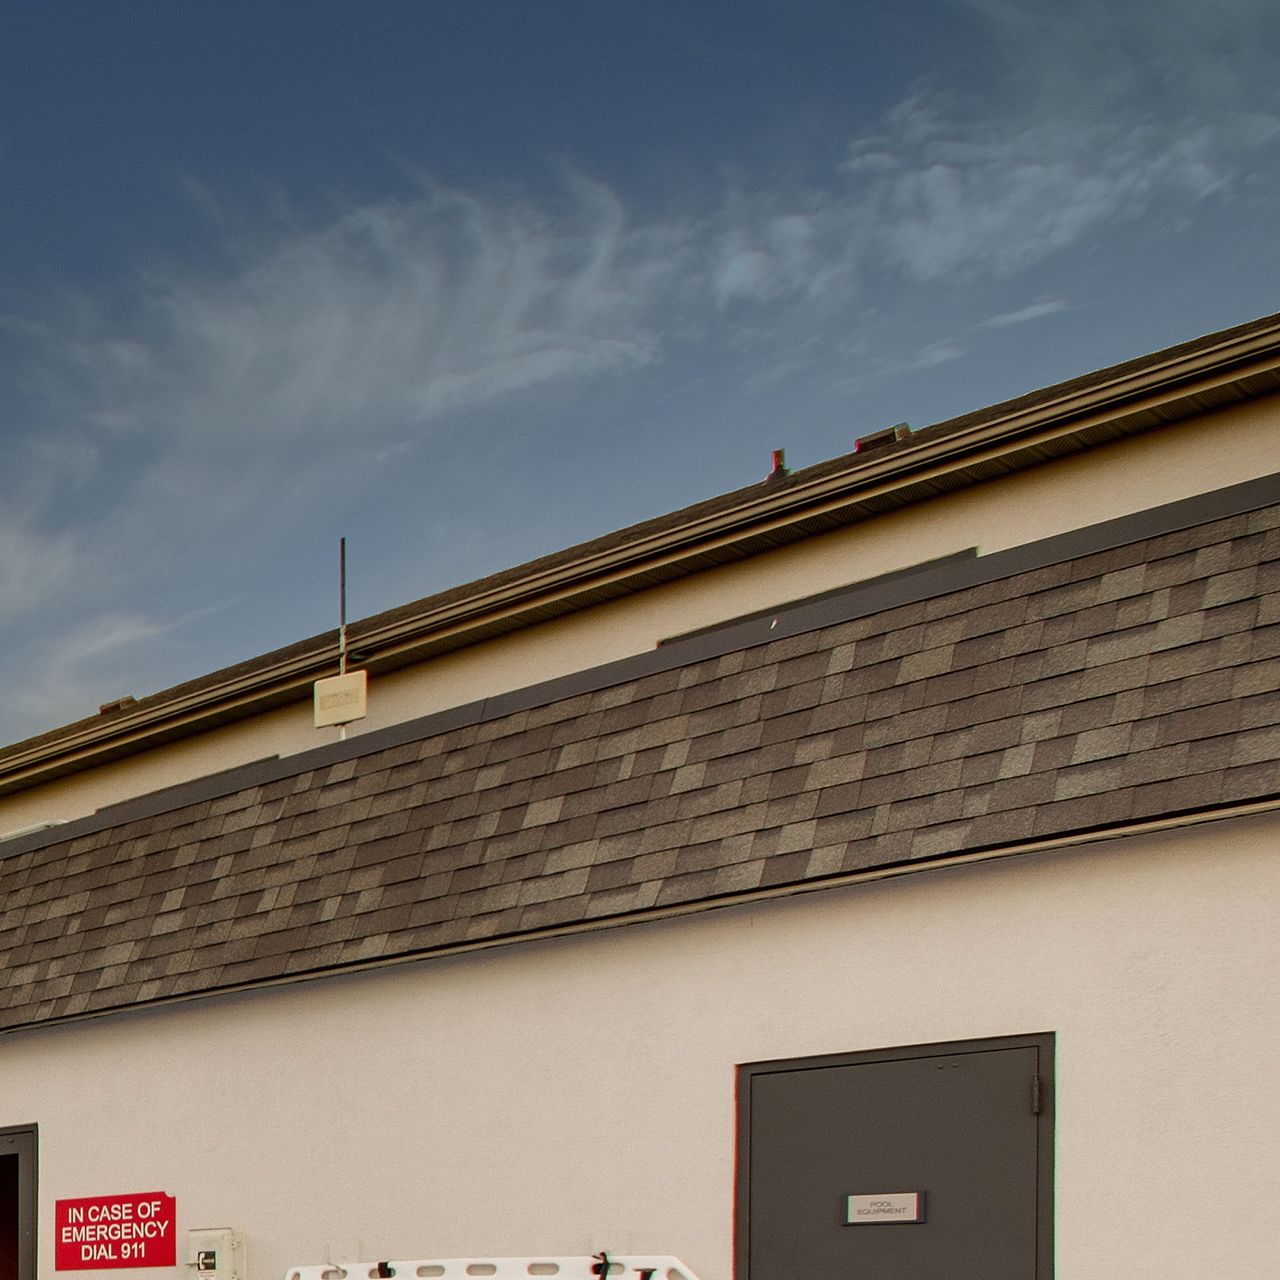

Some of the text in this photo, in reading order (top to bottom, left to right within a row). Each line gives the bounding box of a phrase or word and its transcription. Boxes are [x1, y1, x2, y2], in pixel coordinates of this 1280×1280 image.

[68, 1201, 161, 1223] IN CASE OF
[857, 1207, 907, 1215] EQUIPMENT
[870, 1200, 893, 1208] POOL
[62, 1220, 169, 1243] EMERGENCY
[81, 1242, 146, 1261] DIAL 911
